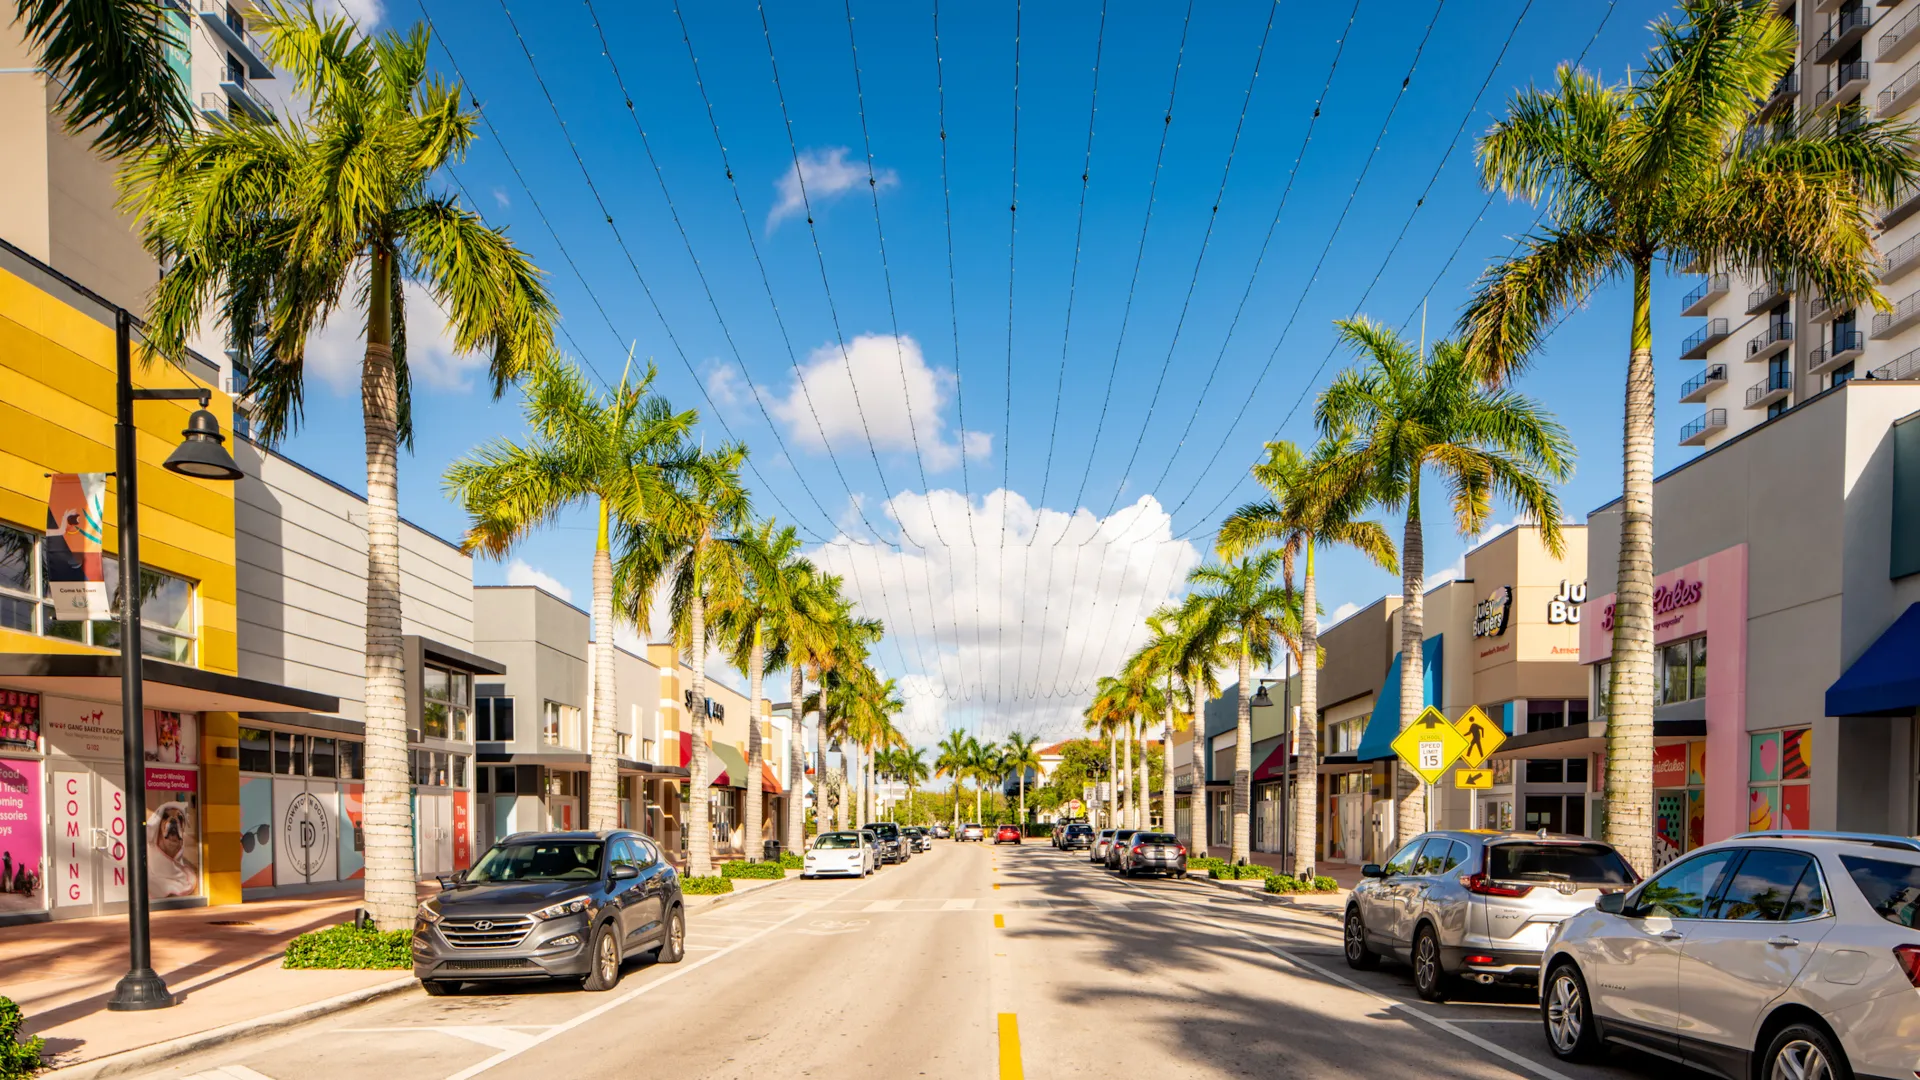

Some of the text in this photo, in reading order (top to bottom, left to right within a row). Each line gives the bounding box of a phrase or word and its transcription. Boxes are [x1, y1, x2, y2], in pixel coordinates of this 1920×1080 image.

[1554, 580, 1587, 603] Ju
[1474, 600, 1494, 620] Juicy
[1472, 613, 1502, 637] Burgers
[68, 724, 84, 732] GANG
[1424, 755, 1438, 766] 15
[151, 772, 186, 782] Award-Winning
[3, 782, 29, 793] Treats
[147, 780, 190, 789] Grooming Services
[0, 796, 23, 809] ming
[456, 806, 466, 816] The
[458, 821, 466, 830] art
[66, 779, 81, 901] COMING
[111, 792, 126, 886] SOON
